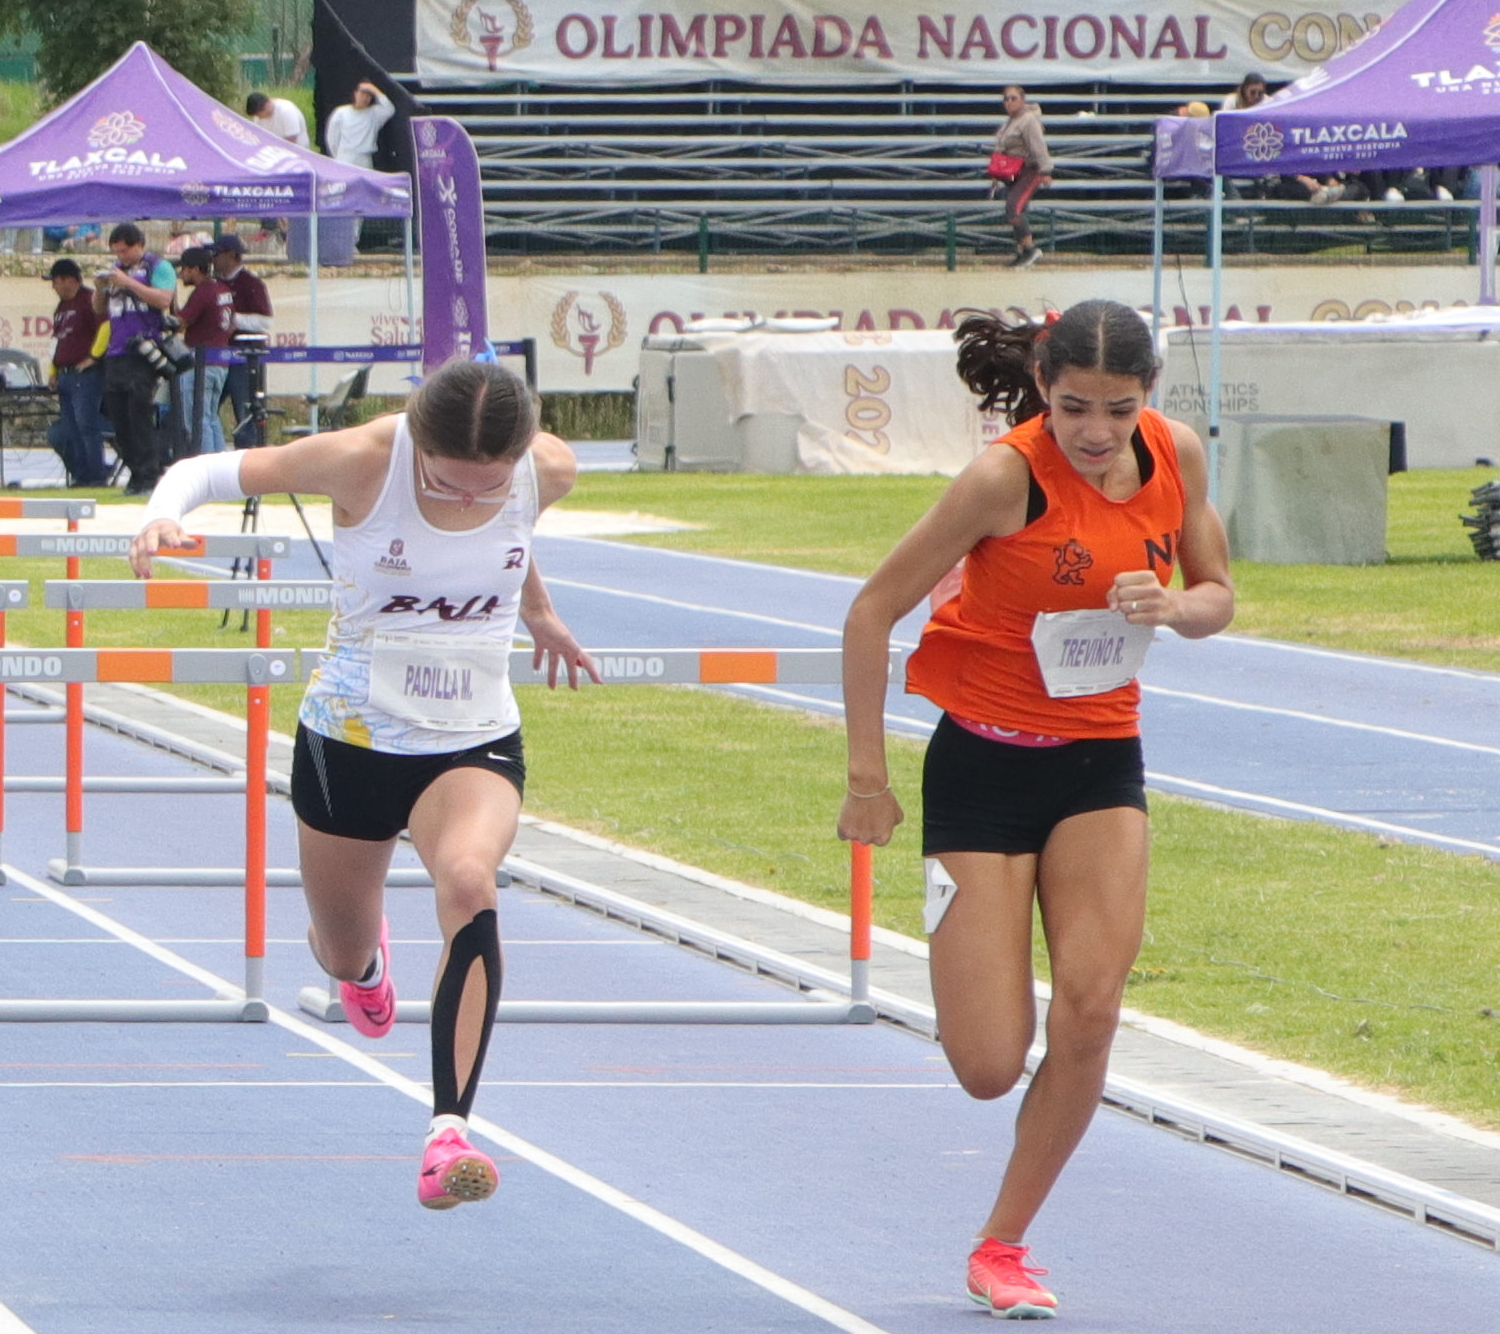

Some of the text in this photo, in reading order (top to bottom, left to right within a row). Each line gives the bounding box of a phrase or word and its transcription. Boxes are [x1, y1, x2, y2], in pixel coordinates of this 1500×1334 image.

[555, 13, 893, 59] OLIMPIADA
[918, 14, 1227, 60] NACIONAL
[1291, 122, 1408, 144] TLAXCALA
[29, 147, 187, 176] TLAXCALA
[215, 185, 294, 198] TLAXCALA
[56, 538, 131, 553] MONDO
[404, 665, 473, 701] PADILLA M.
